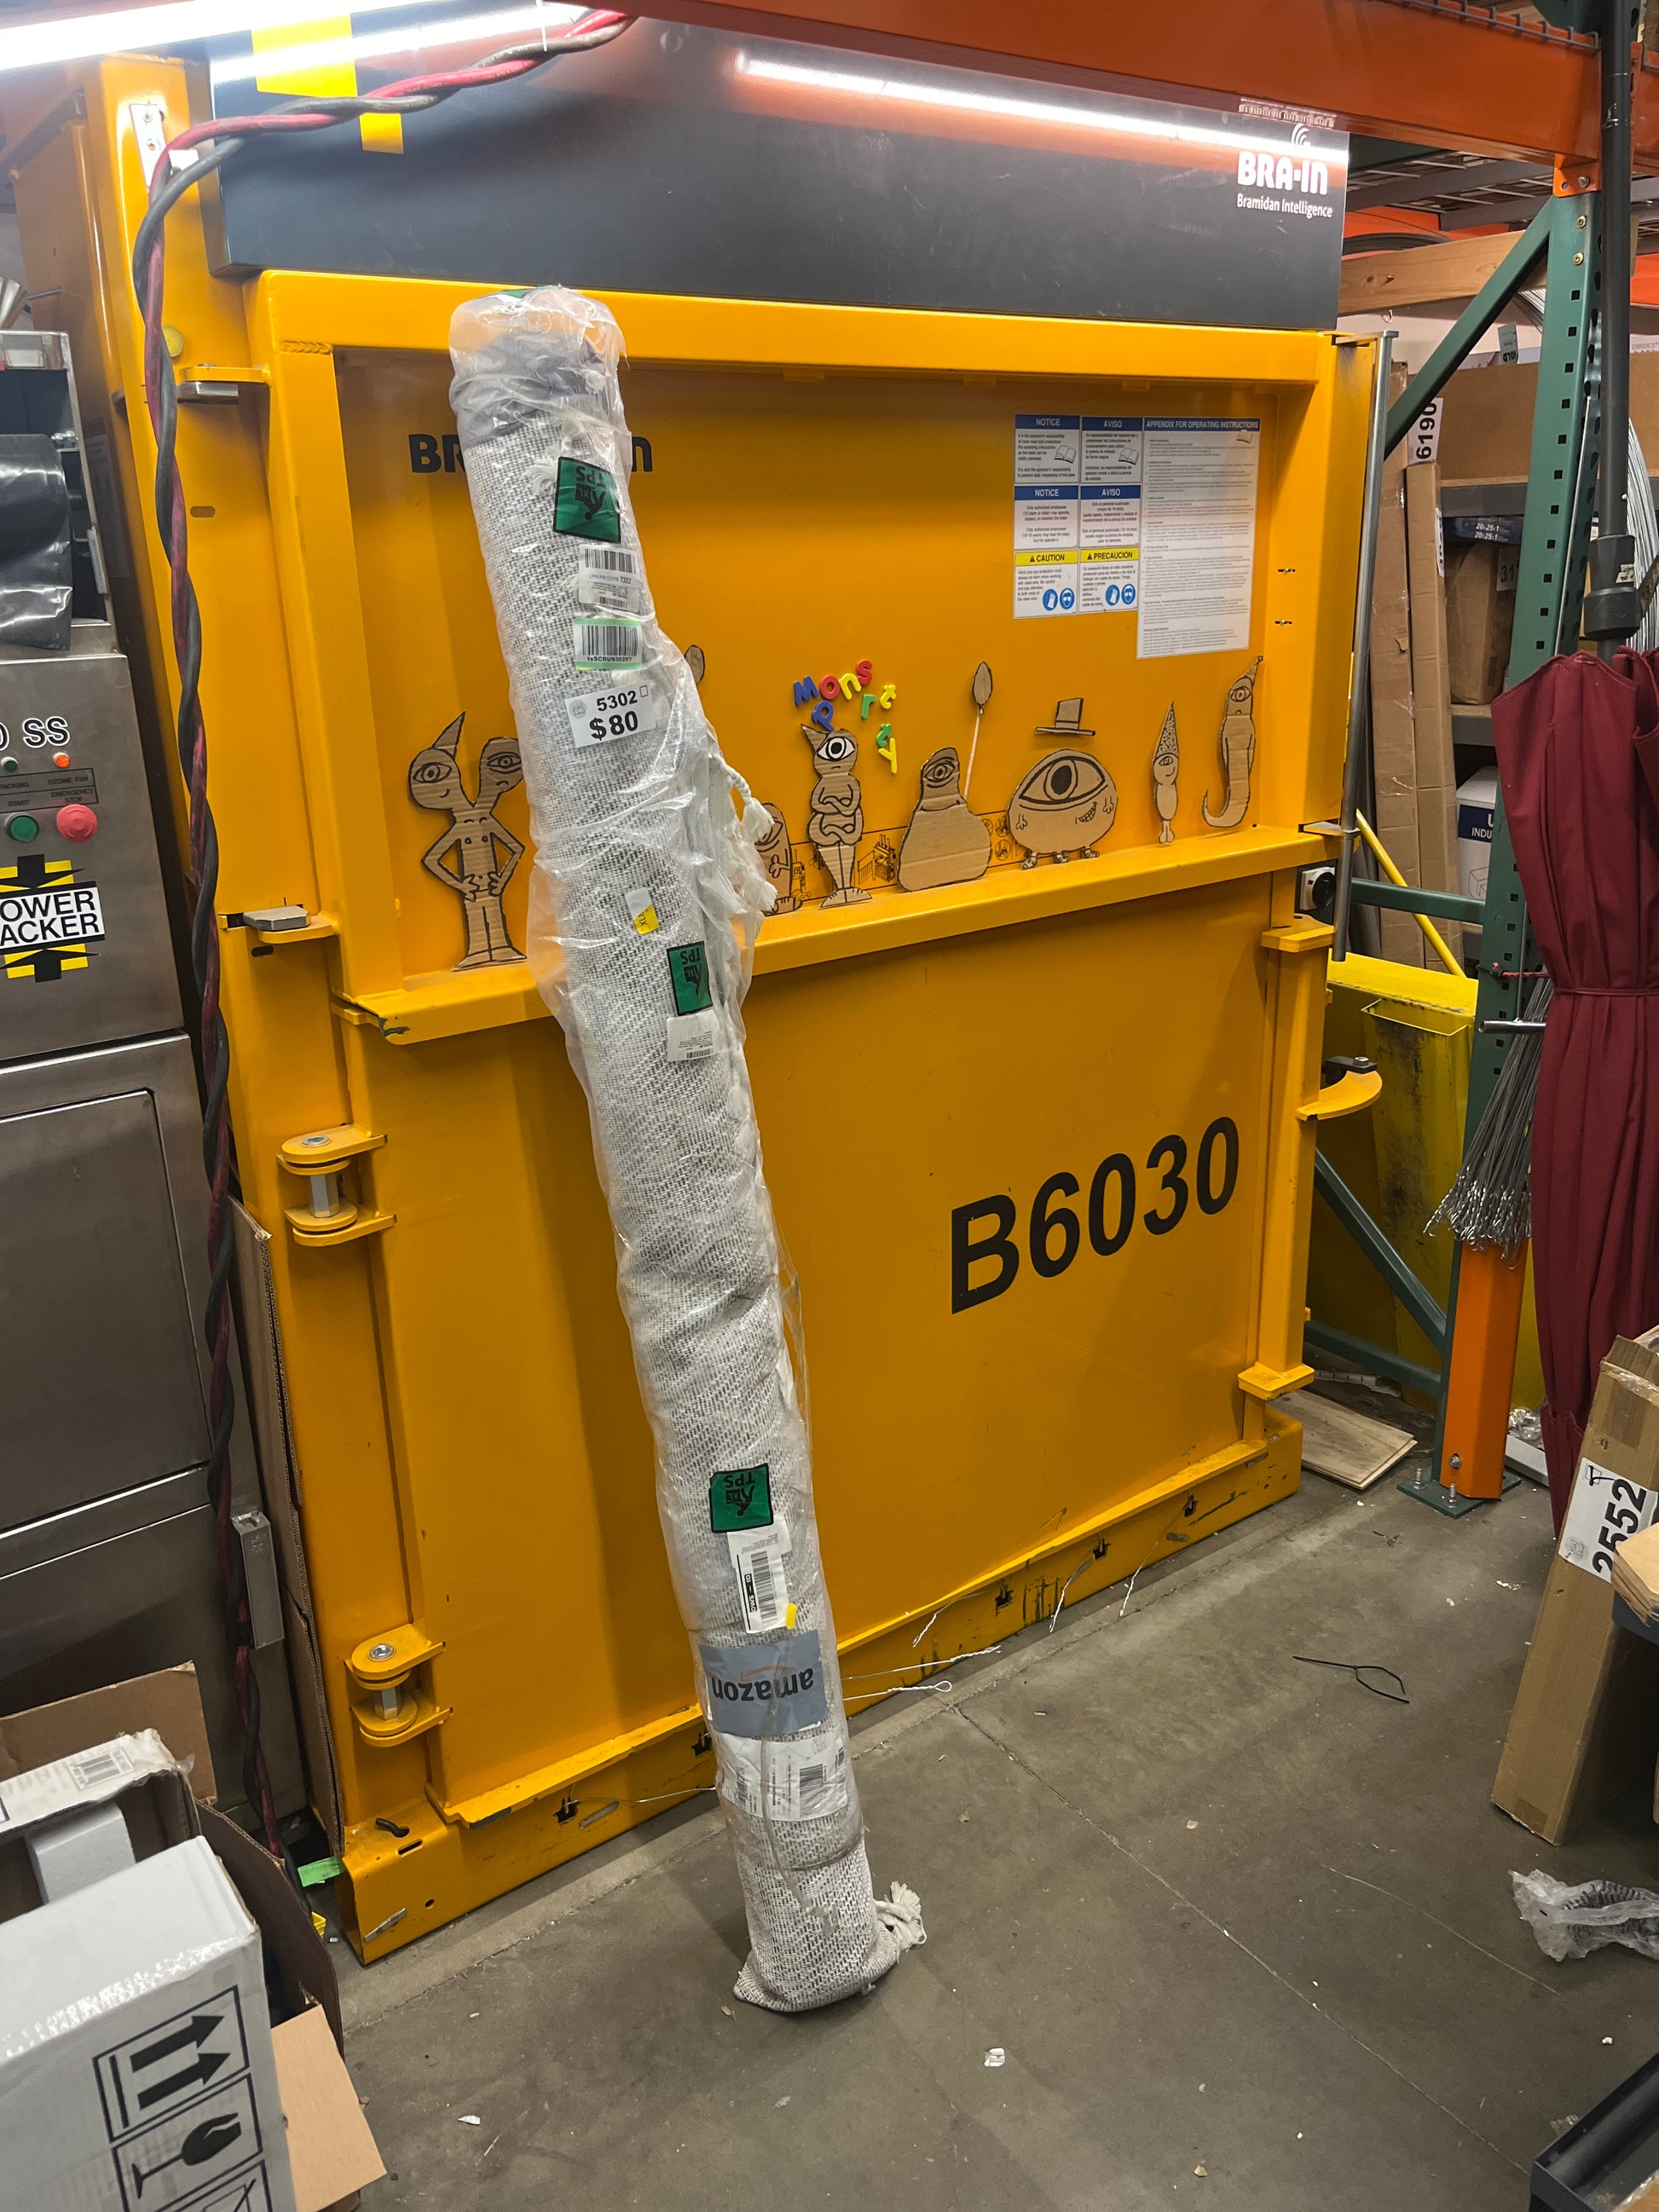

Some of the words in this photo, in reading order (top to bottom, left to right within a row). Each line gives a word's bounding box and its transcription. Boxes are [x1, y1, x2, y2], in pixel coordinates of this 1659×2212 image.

[1237, 193, 1280, 212] Bramidan
[1281, 199, 1333, 219] Intelligence
[1036, 418, 1061, 426] NOTICE
[1416, 403, 1436, 459] 6190
[575, 466, 605, 488] TPS
[1035, 488, 1059, 497] NOTICE
[1037, 554, 1065, 563] CAUTION
[1094, 551, 1133, 560] PRECAUCIÓN
[597, 690, 638, 711] 5302
[22, 716, 70, 748] SS
[589, 711, 639, 741] $80
[48, 777, 72, 785] OZONE
[51, 788, 94, 797] EMERGENCY
[1471, 827, 1493, 839] INDU
[0, 891, 95, 922] OWER
[0, 913, 100, 946] ACKER
[679, 947, 702, 965] TPS
[951, 1116, 1240, 1315] B6030
[723, 1470, 755, 1490] TPS
[749, 1595, 757, 1612] DWS
[711, 1667, 814, 1701] amazon
